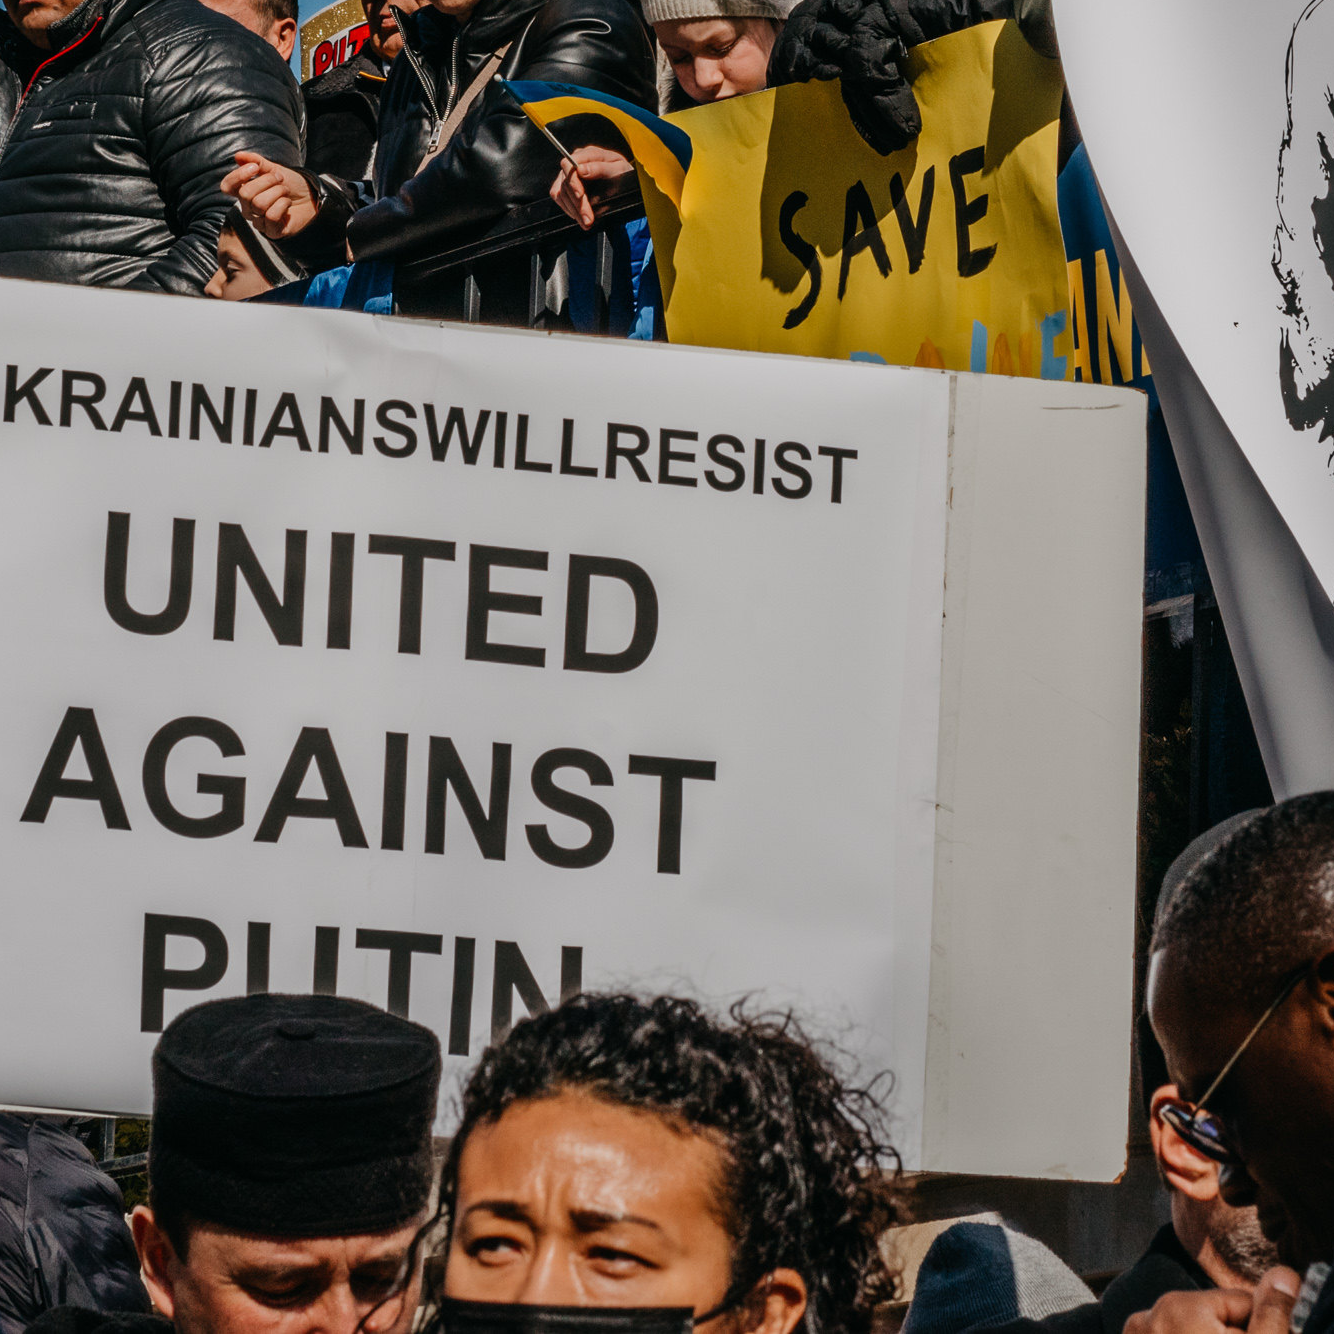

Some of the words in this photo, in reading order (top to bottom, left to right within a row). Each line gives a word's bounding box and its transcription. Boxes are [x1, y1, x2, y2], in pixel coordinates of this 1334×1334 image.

[778, 145, 998, 330] SAVE
[104, 511, 658, 674] UNITED
[20, 706, 716, 875] AGAINST
[141, 913, 582, 1057] PUTIN
